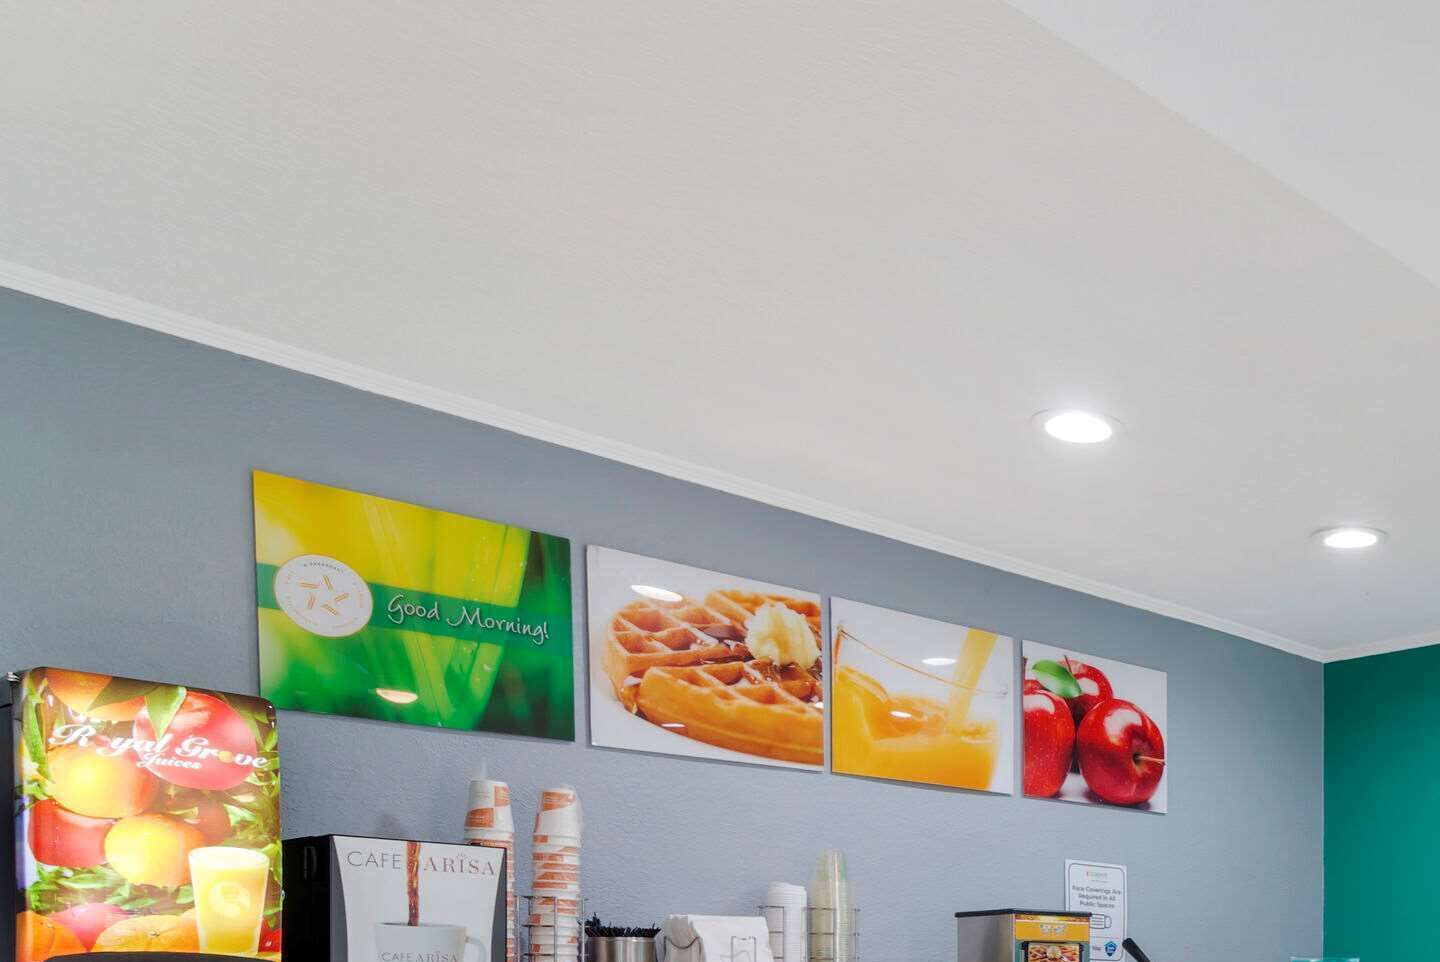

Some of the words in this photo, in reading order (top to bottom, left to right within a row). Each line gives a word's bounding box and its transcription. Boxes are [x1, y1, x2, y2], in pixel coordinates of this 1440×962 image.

[387, 594, 440, 625] Good
[446, 606, 550, 646] Morning!
[47, 723, 174, 757] Royal
[175, 735, 269, 769] Grove
[135, 751, 203, 770] Juices
[346, 850, 401, 870] CAFE
[380, 952, 413, 962] CAFE
